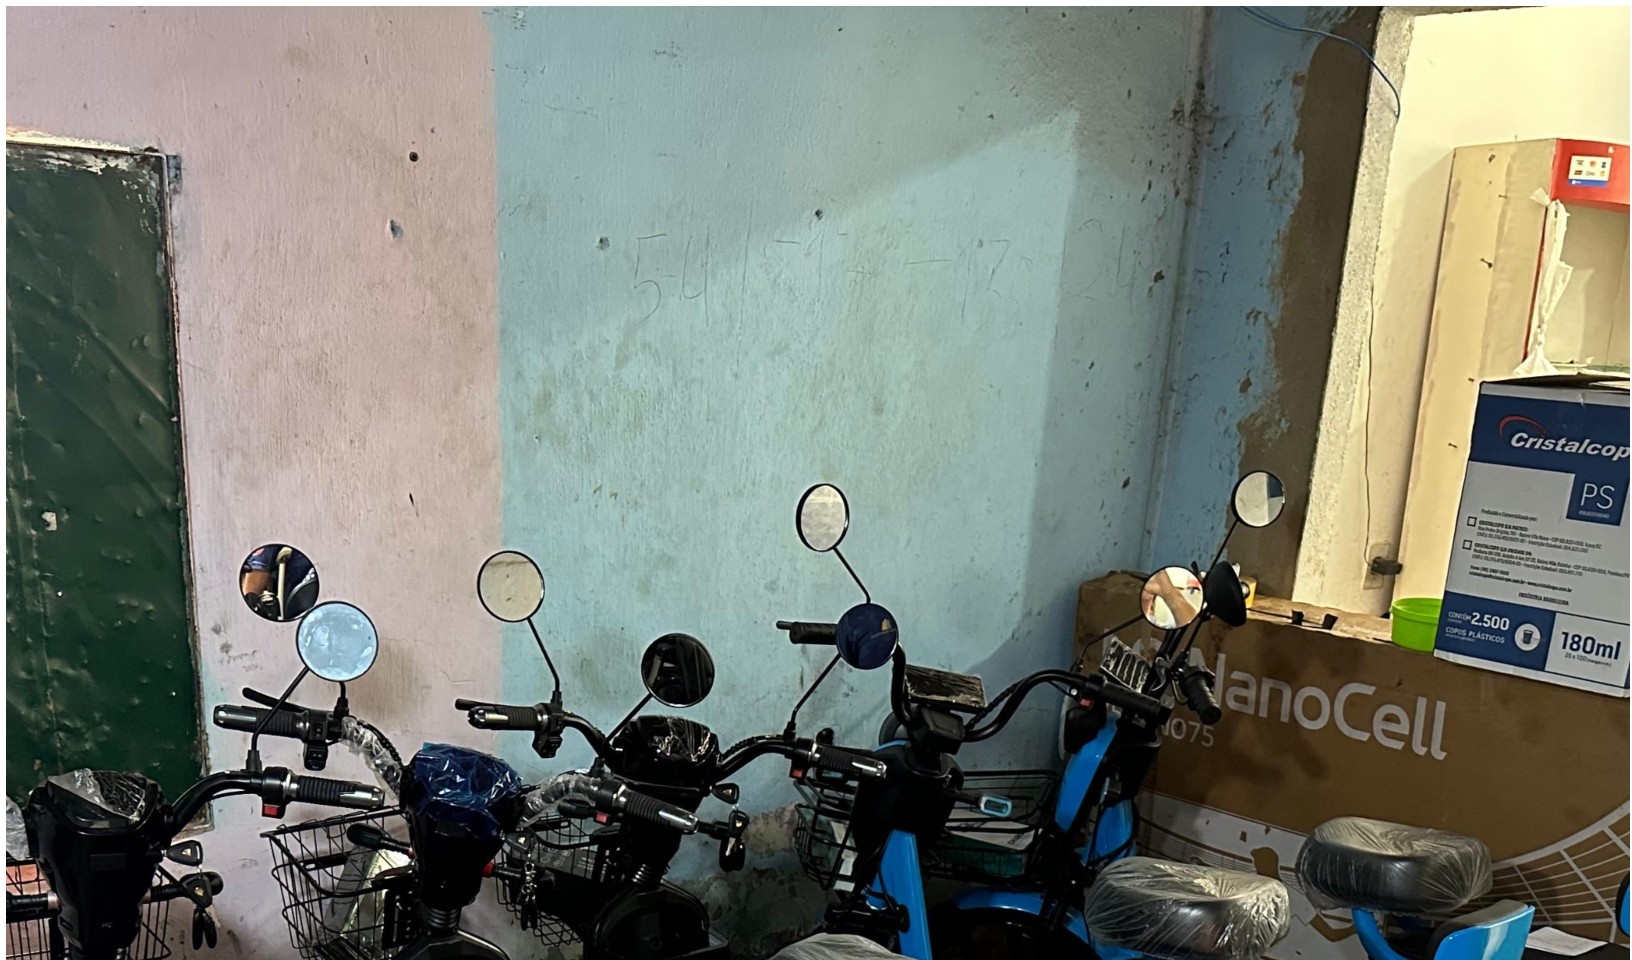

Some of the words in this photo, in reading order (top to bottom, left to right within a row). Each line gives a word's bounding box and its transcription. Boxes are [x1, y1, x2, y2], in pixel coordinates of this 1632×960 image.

[1511, 432, 1630, 461] Cristalcop
[1580, 483, 1615, 509] PS
[1471, 612, 1510, 630] 2.500
[1445, 626, 1467, 636] COPOS
[1468, 630, 1505, 643] PLÁSTICOS
[1561, 631, 1622, 660] 180ml
